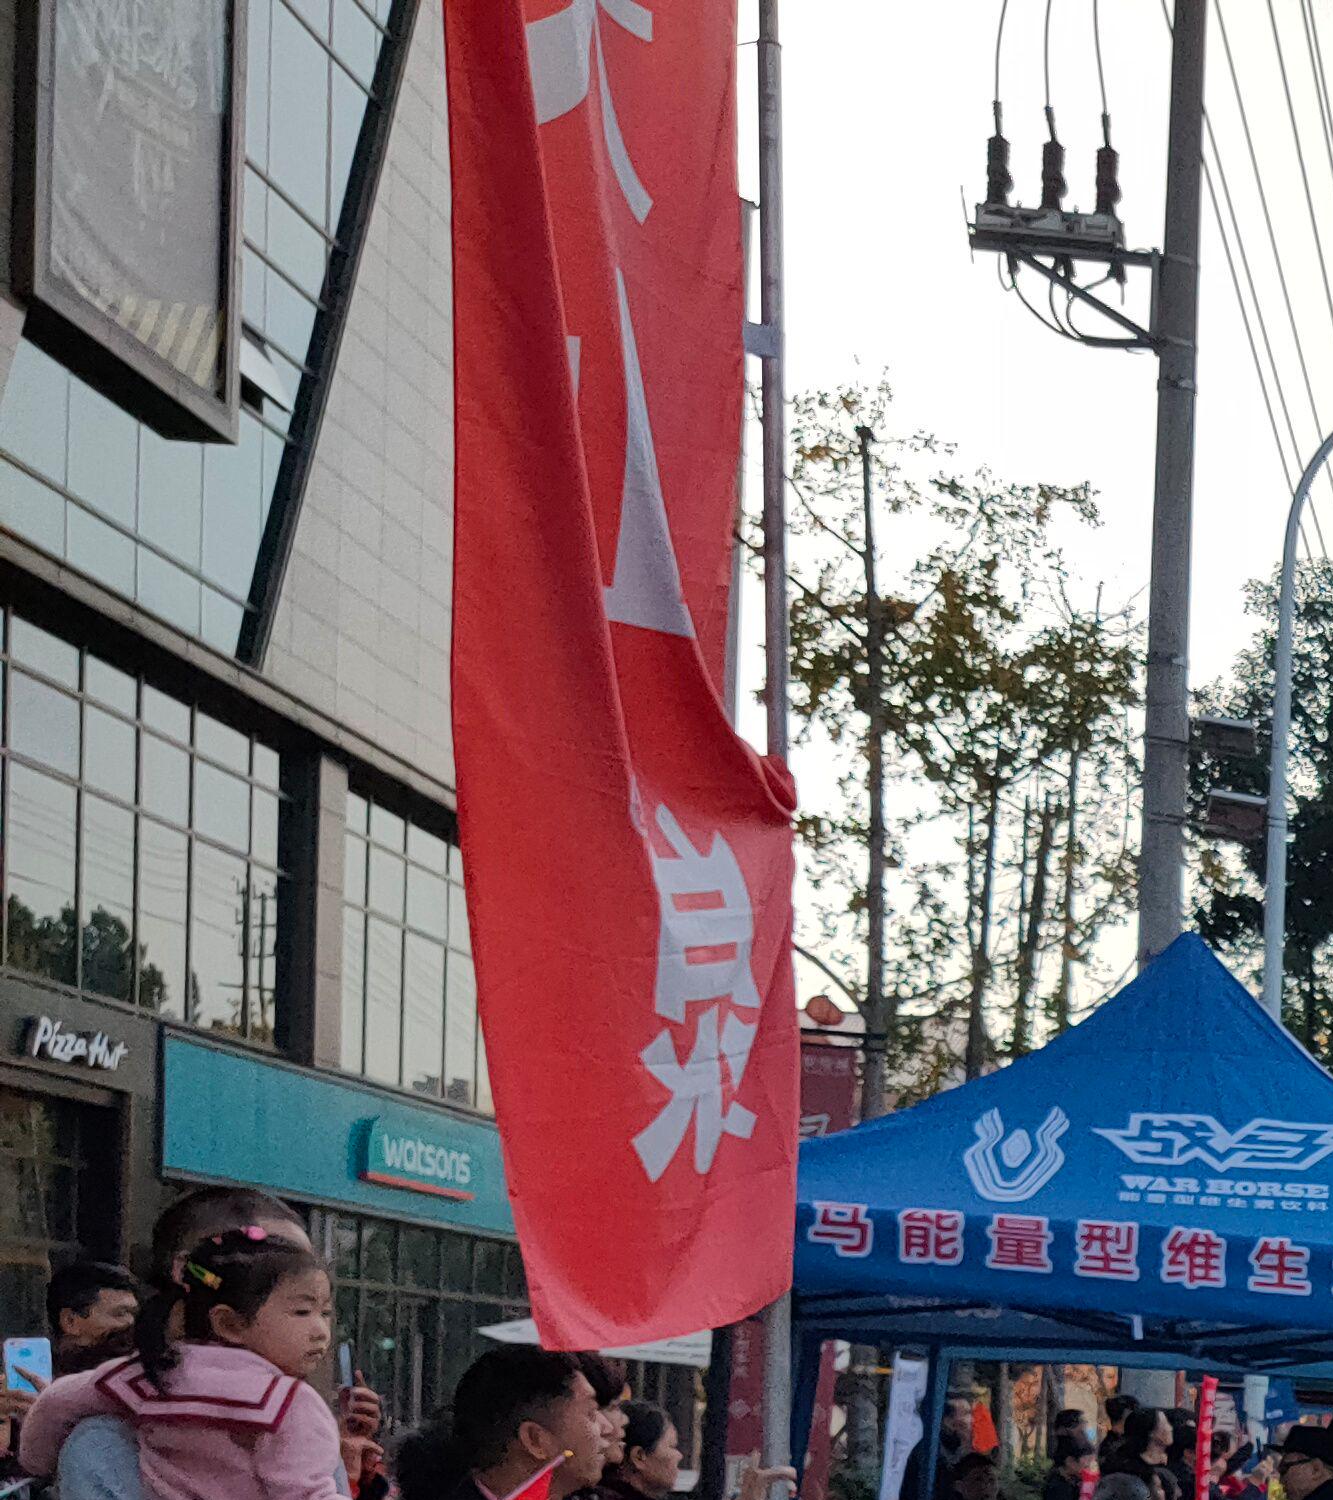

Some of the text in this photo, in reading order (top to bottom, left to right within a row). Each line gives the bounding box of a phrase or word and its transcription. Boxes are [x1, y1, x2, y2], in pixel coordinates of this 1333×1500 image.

[31, 1016, 129, 1071] Pizza Hut
[384, 1133, 471, 1184] watsons
[1120, 1175, 1330, 1199] WAR HORSE
